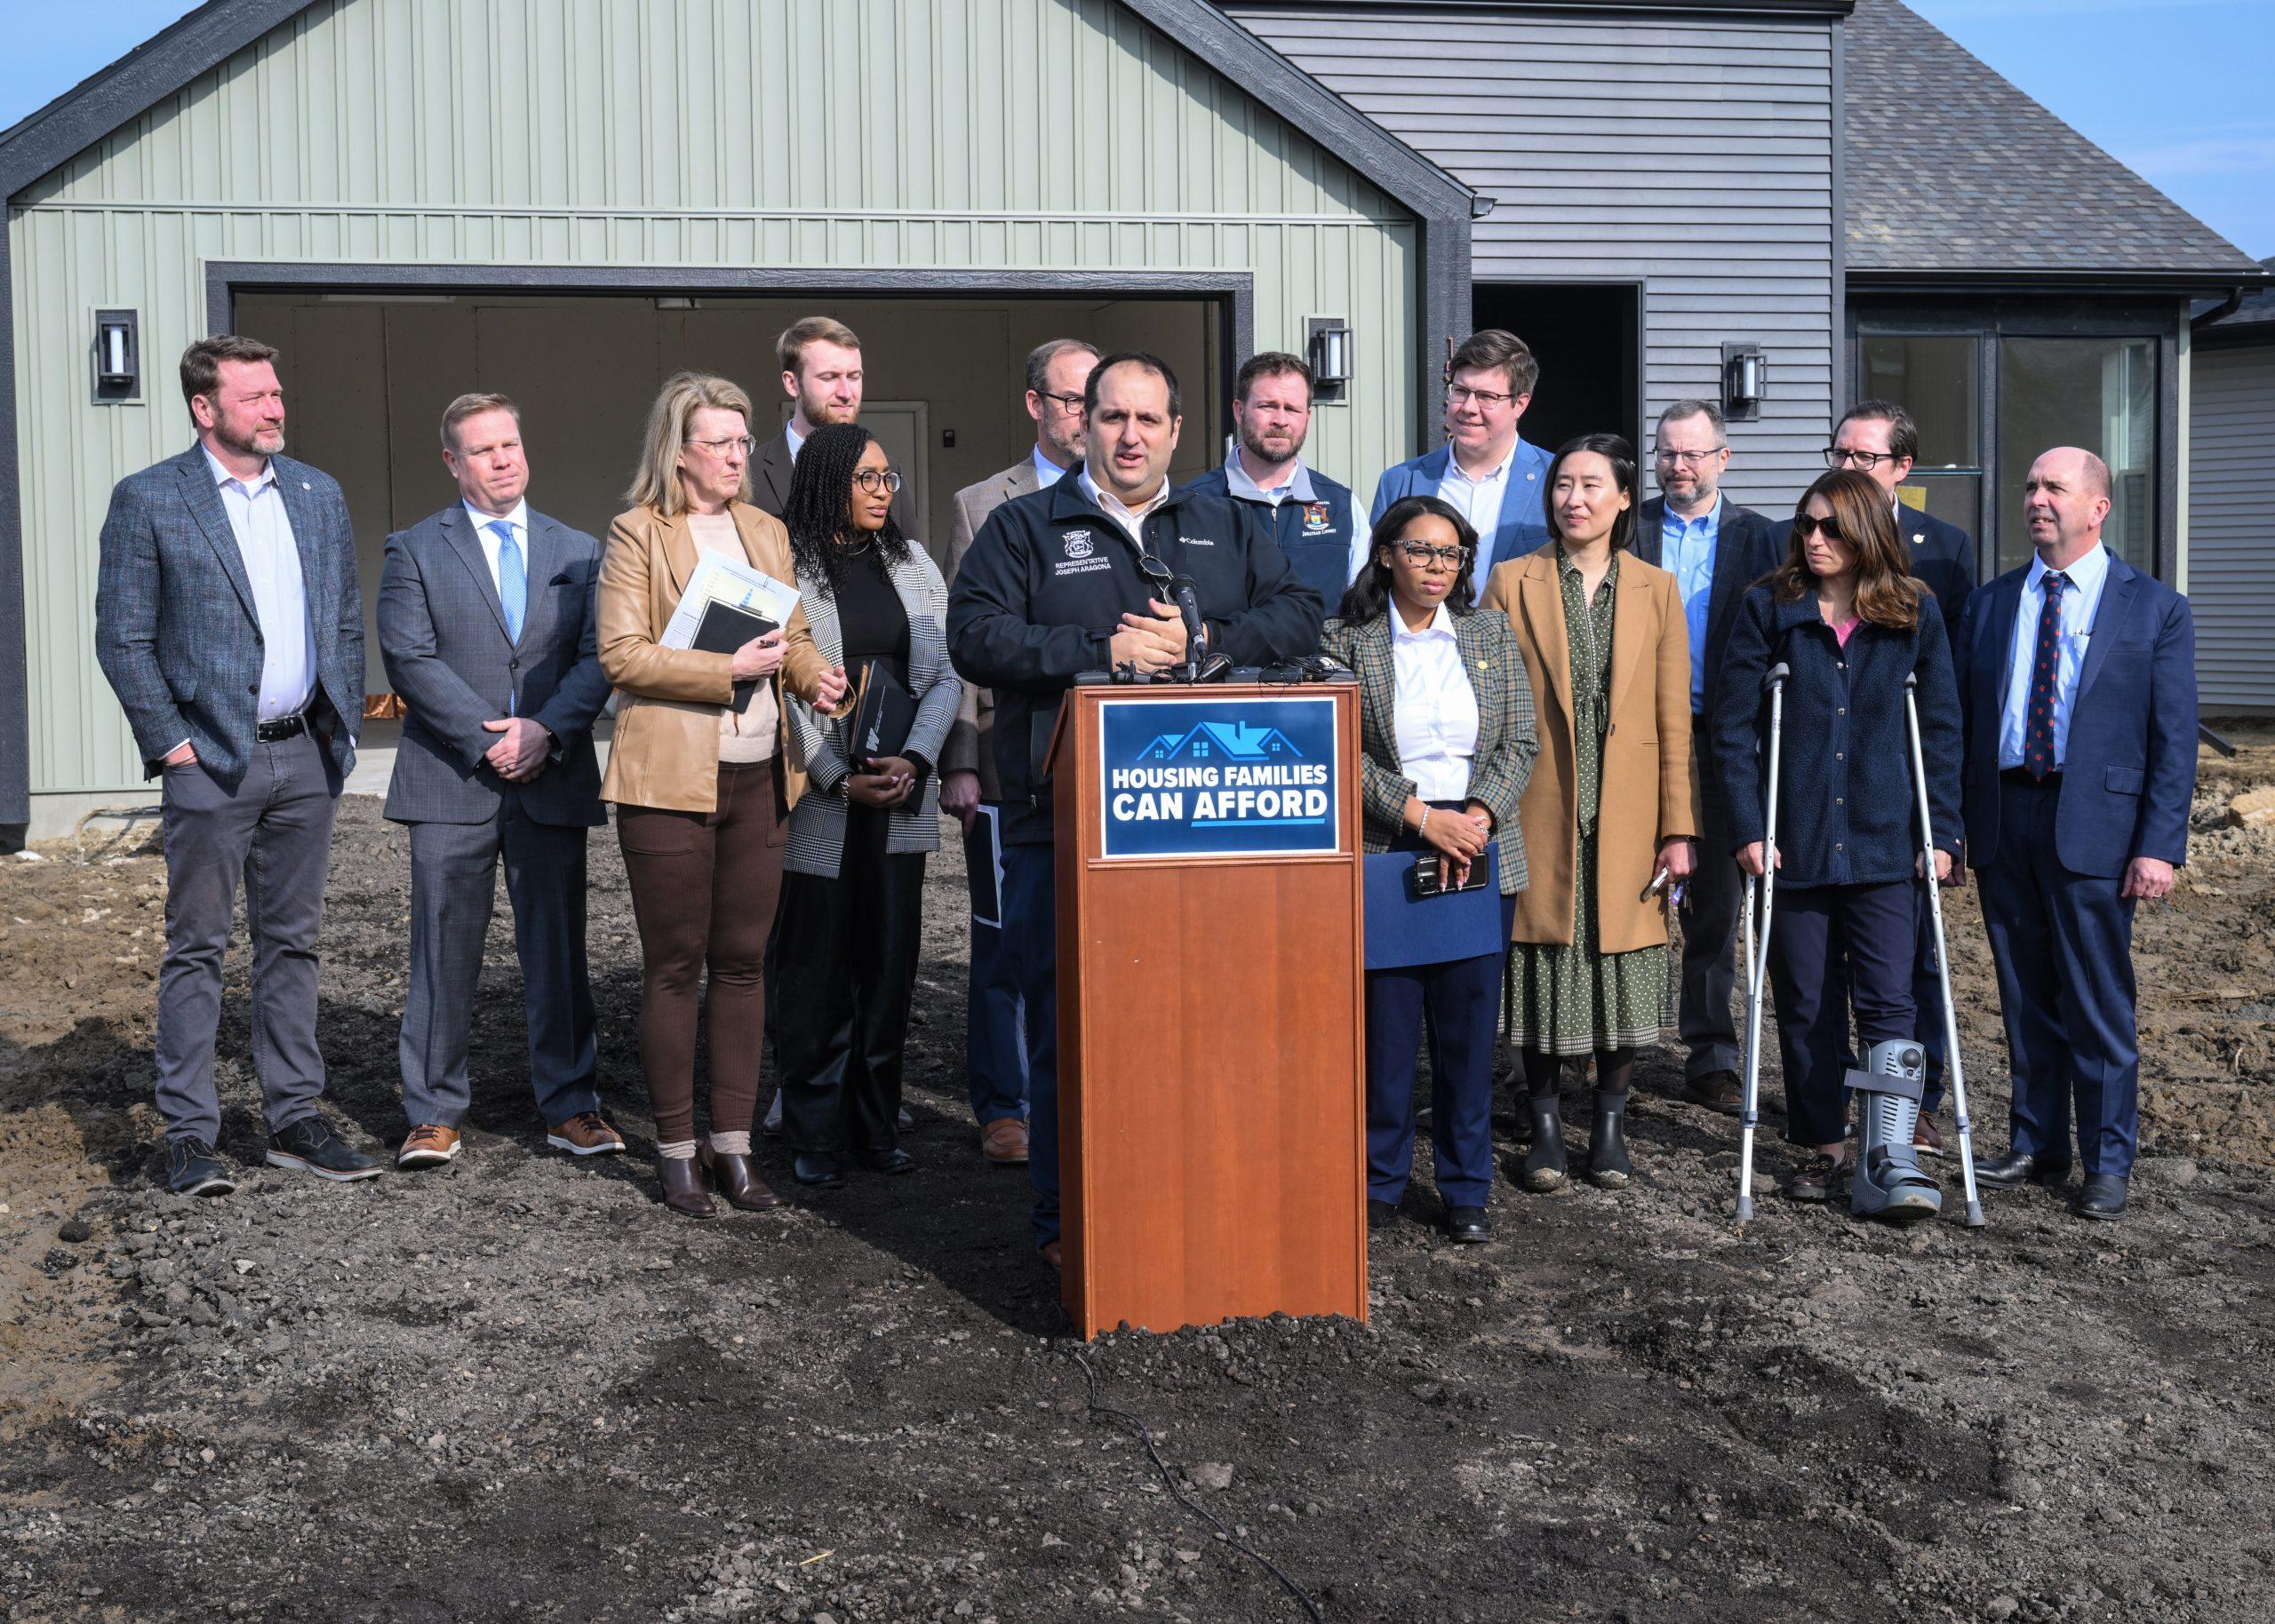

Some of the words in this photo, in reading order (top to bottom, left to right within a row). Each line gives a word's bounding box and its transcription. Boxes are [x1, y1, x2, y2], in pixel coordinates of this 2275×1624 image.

[1185, 537, 1215, 546] Columbia
[1055, 557, 1109, 569] REPRESENTATIVE
[1055, 567, 1080, 576] JOSEPH
[1081, 563, 1111, 572] ARAGONA
[1113, 767, 1218, 789] HOUSING
[1225, 764, 1328, 786] FAMILIES
[1113, 792, 1183, 821] CAN
[1193, 789, 1328, 819] AFFORD
